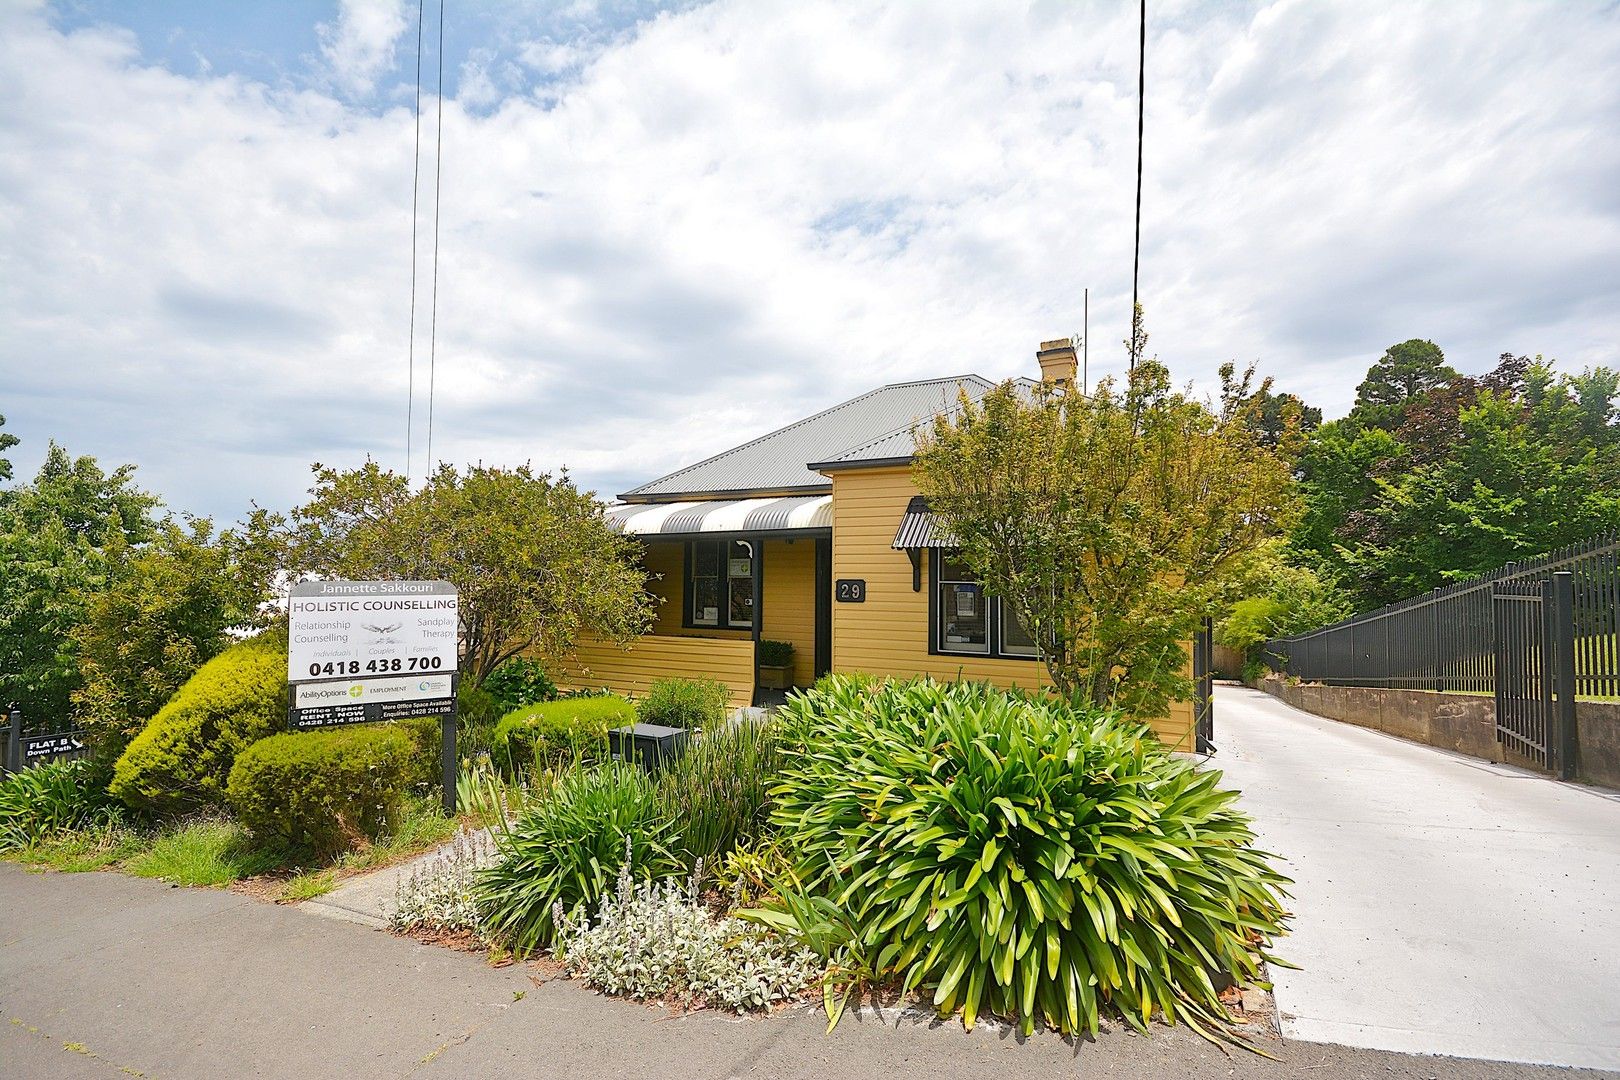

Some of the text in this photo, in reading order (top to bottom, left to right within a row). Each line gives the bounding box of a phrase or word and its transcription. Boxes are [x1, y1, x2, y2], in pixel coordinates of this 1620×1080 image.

[320, 582, 433, 594] Jannette Sakkouri
[841, 584, 860, 598] 29
[293, 600, 456, 612] HOLISTIC COUNSELLING
[294, 620, 351, 631] Relationship
[417, 617, 455, 627] Sandplay
[294, 633, 349, 644] Counselling
[422, 629, 454, 639] Therapy
[313, 649, 351, 658] Individuals
[368, 647, 395, 656] Couples
[412, 645, 438, 653] Families
[309, 656, 441, 676] 0418 438 700
[300, 690, 347, 699] AbilityOptions
[370, 686, 407, 694] EMPLOYMENT
[29, 740, 56, 749] FLAT
